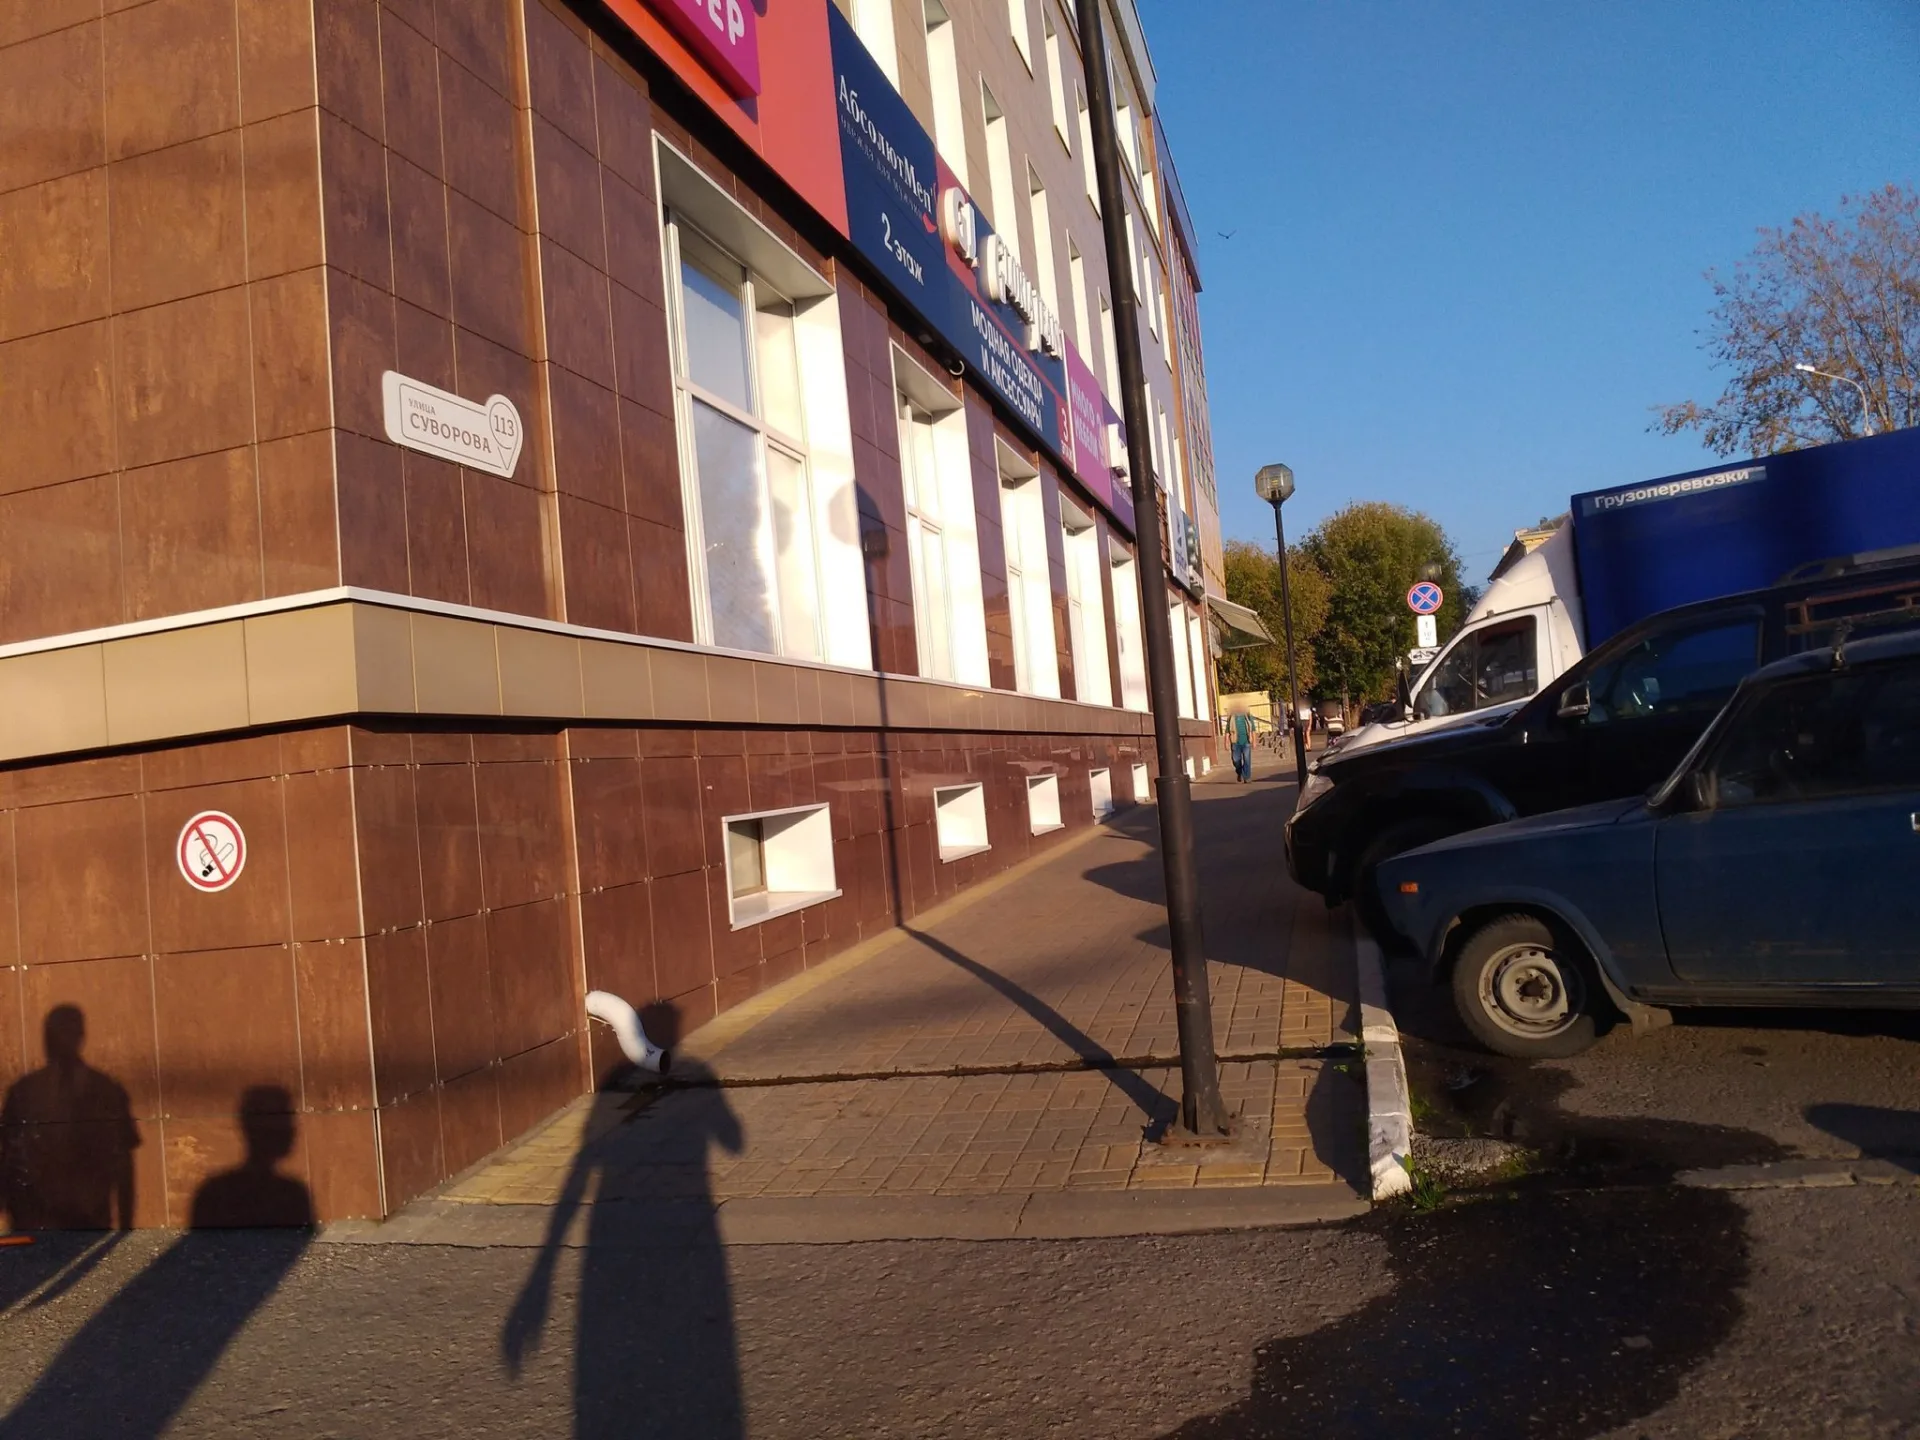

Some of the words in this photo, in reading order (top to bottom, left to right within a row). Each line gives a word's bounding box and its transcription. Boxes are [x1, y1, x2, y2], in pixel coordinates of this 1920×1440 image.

[880, 212, 893, 253] 2
[894, 239, 925, 286] этаж
[971, 300, 1011, 368] МОДНАЯ
[1011, 350, 1044, 406] ОДЕЖДА
[408, 397, 437, 416] УЛИЦА
[981, 344, 990, 376] И
[991, 355, 1043, 432] АКСЕССУАРЫ
[409, 412, 492, 454] СУВОРОВА
[493, 414, 515, 437] 113
[1061, 407, 1069, 442] 3
[1593, 469, 1750, 509] Грузоперевозки
